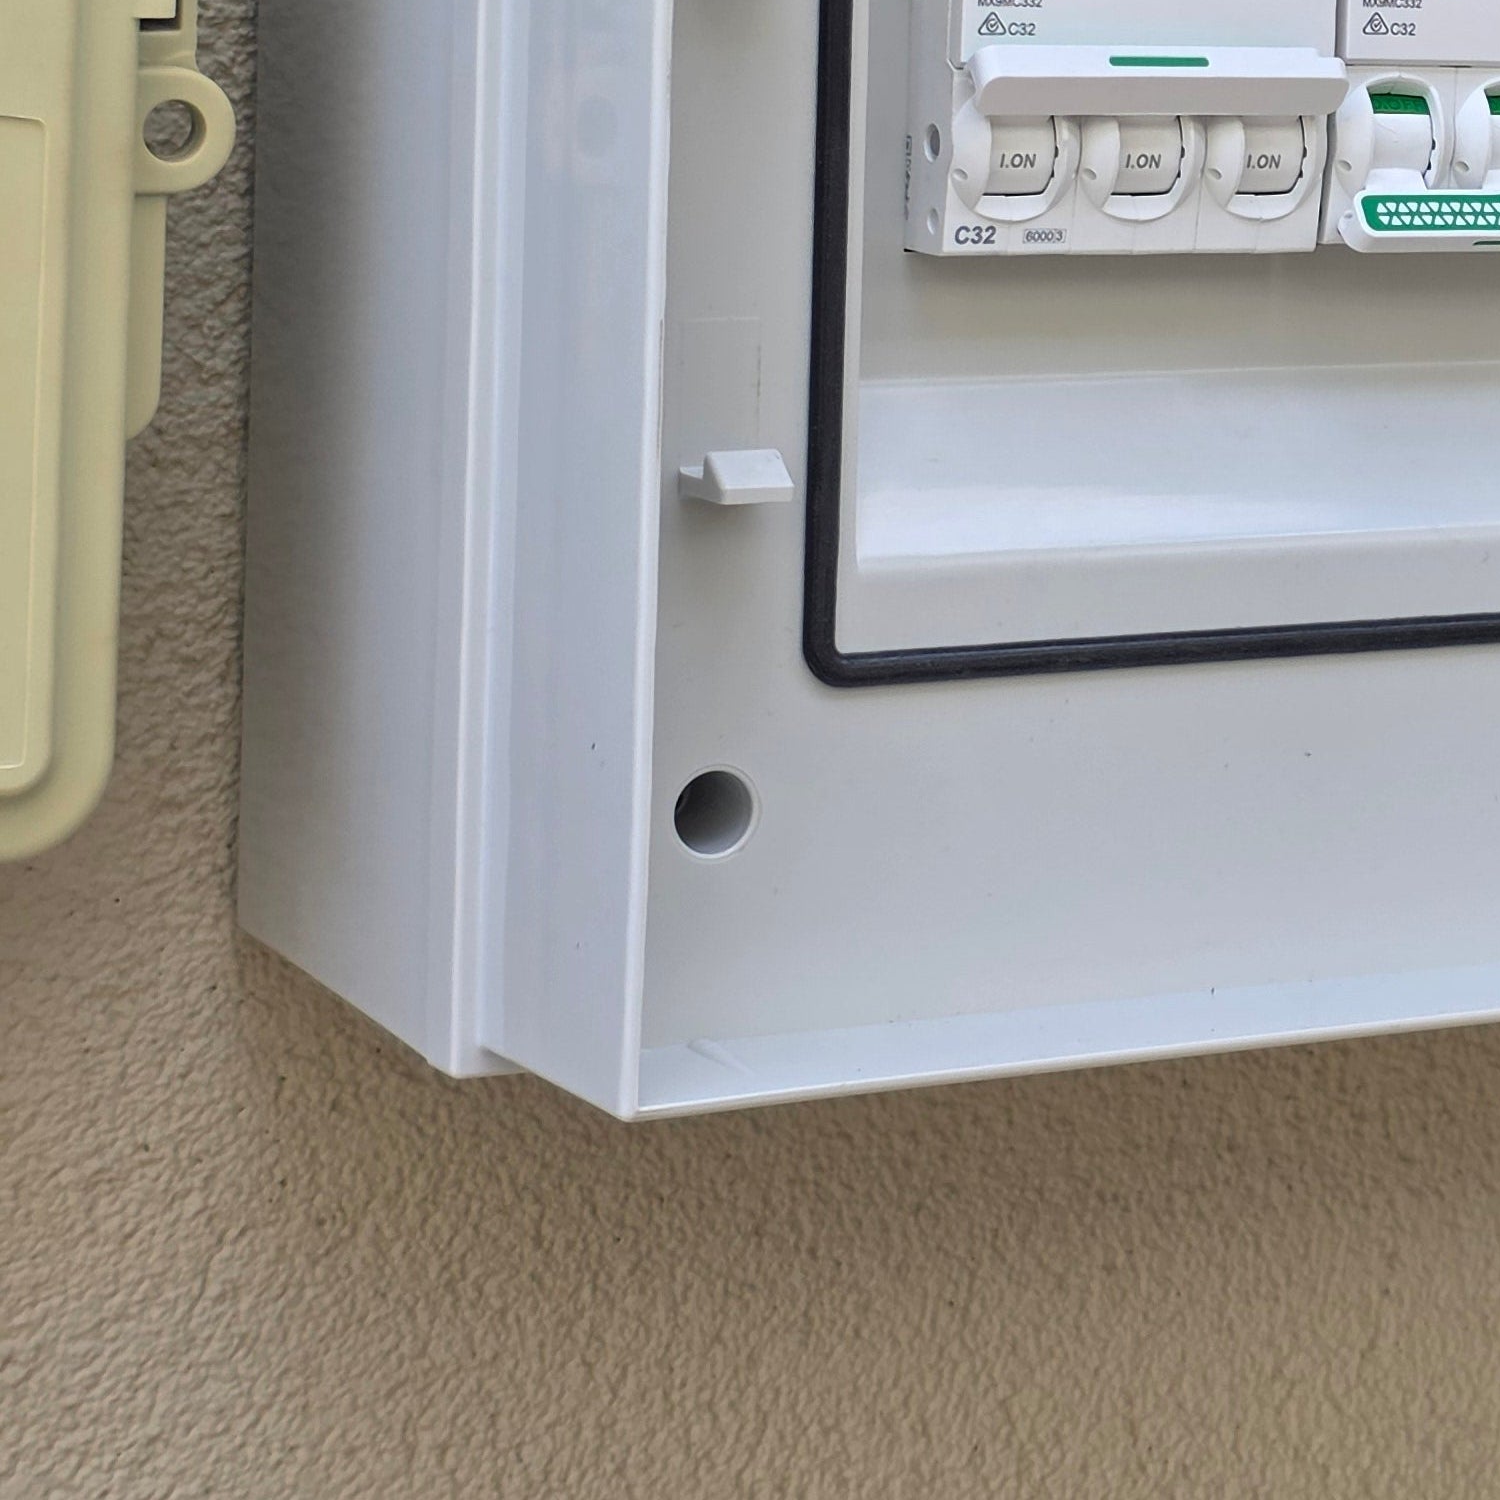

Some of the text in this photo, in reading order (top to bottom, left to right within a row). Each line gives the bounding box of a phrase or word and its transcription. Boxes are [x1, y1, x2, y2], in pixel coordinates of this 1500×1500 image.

[1007, 22, 1036, 36] C32
[1390, 22, 1417, 36] C32
[1000, 153, 1036, 169] I.ON
[1125, 153, 1161, 169] I.ON
[1246, 153, 1281, 169] I.ON
[954, 225, 998, 246] C32
